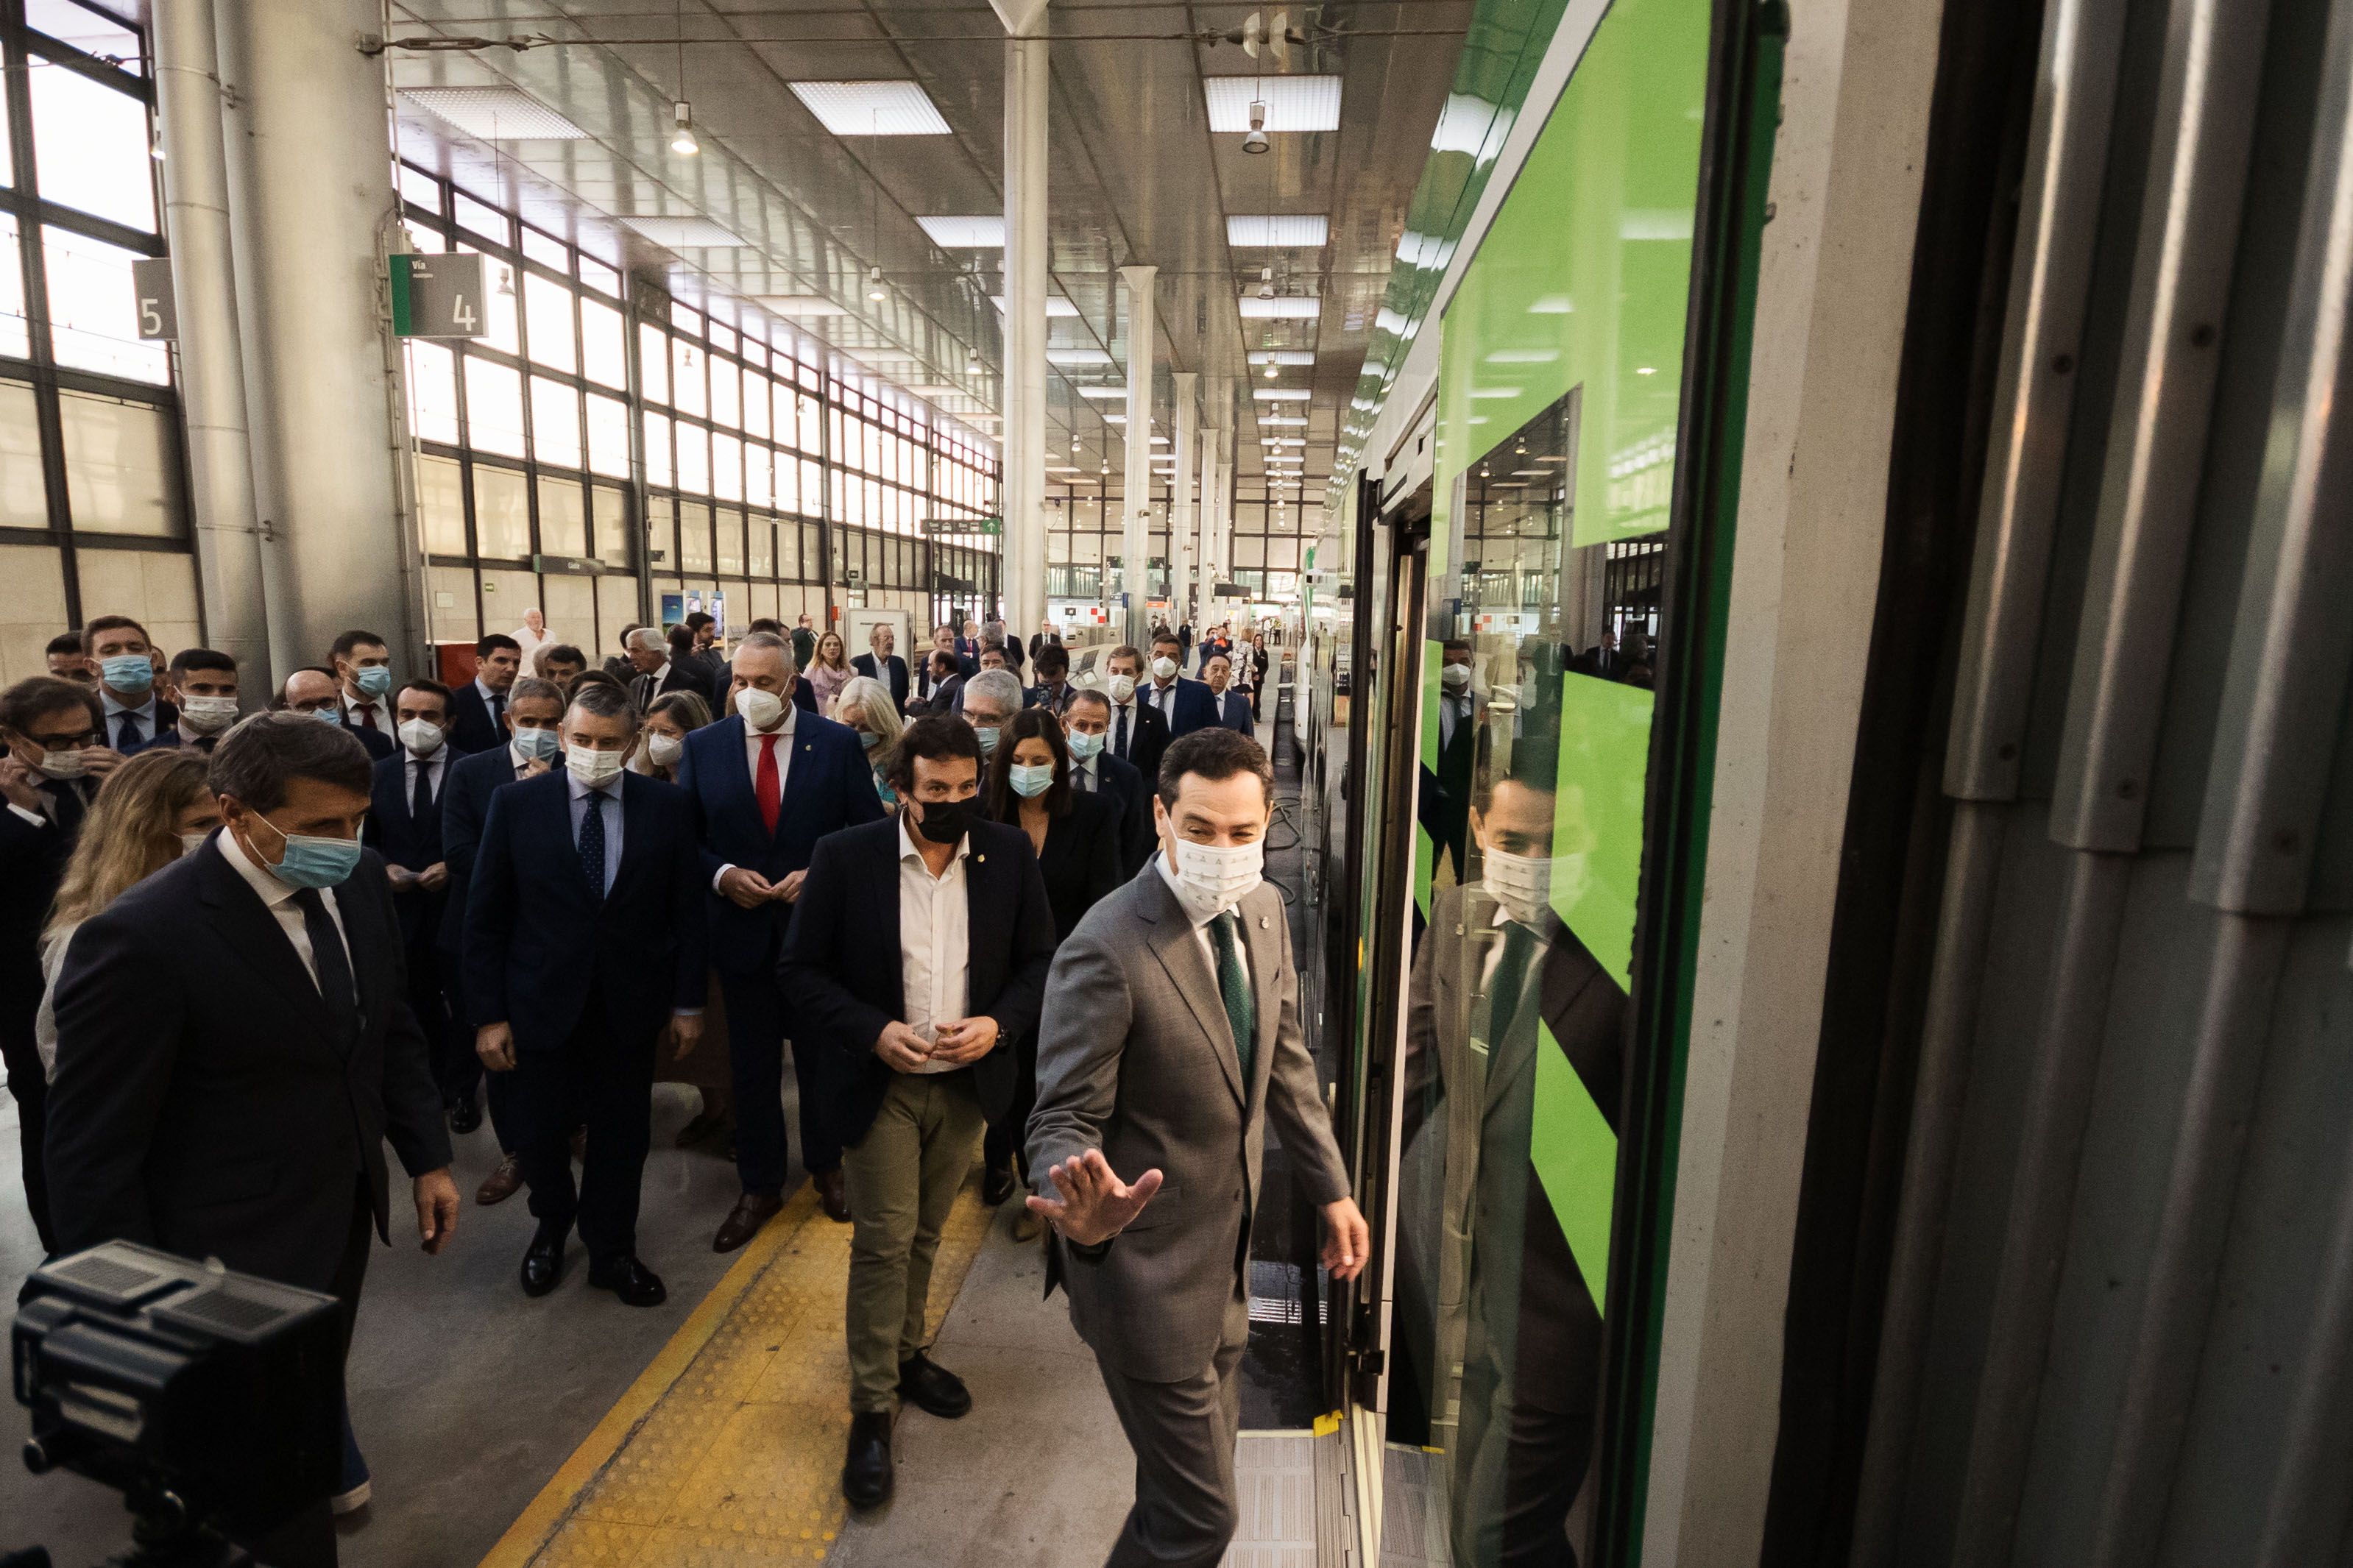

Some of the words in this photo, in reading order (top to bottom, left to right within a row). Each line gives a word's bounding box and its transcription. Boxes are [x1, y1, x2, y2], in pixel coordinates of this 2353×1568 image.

[411, 260, 426, 270] Vía
[141, 299, 162, 336] 5
[453, 294, 477, 332] 4
